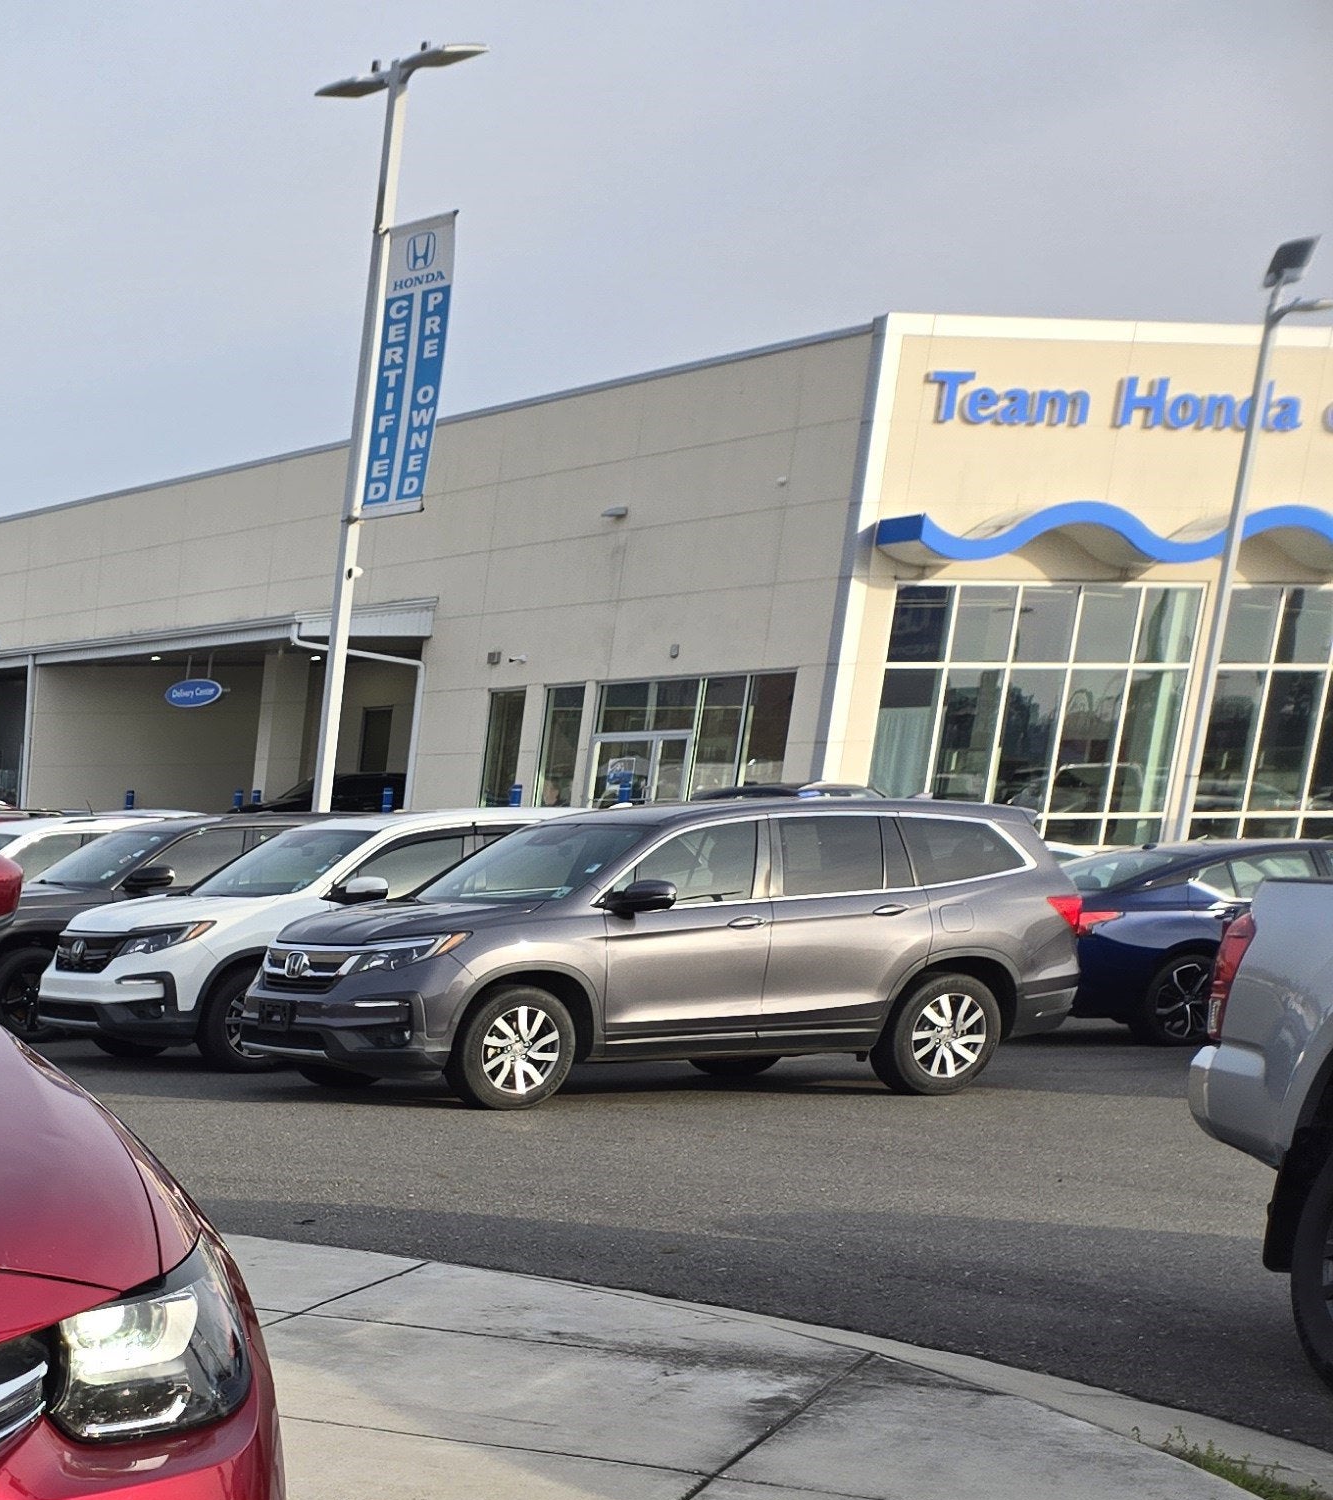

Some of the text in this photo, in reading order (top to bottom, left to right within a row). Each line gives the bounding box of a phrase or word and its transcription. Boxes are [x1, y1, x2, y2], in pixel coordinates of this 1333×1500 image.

[392, 270, 446, 292] HONDA
[367, 299, 409, 501] CERTIFIED
[402, 291, 443, 496] PRE OWNED
[927, 370, 1091, 426] Team
